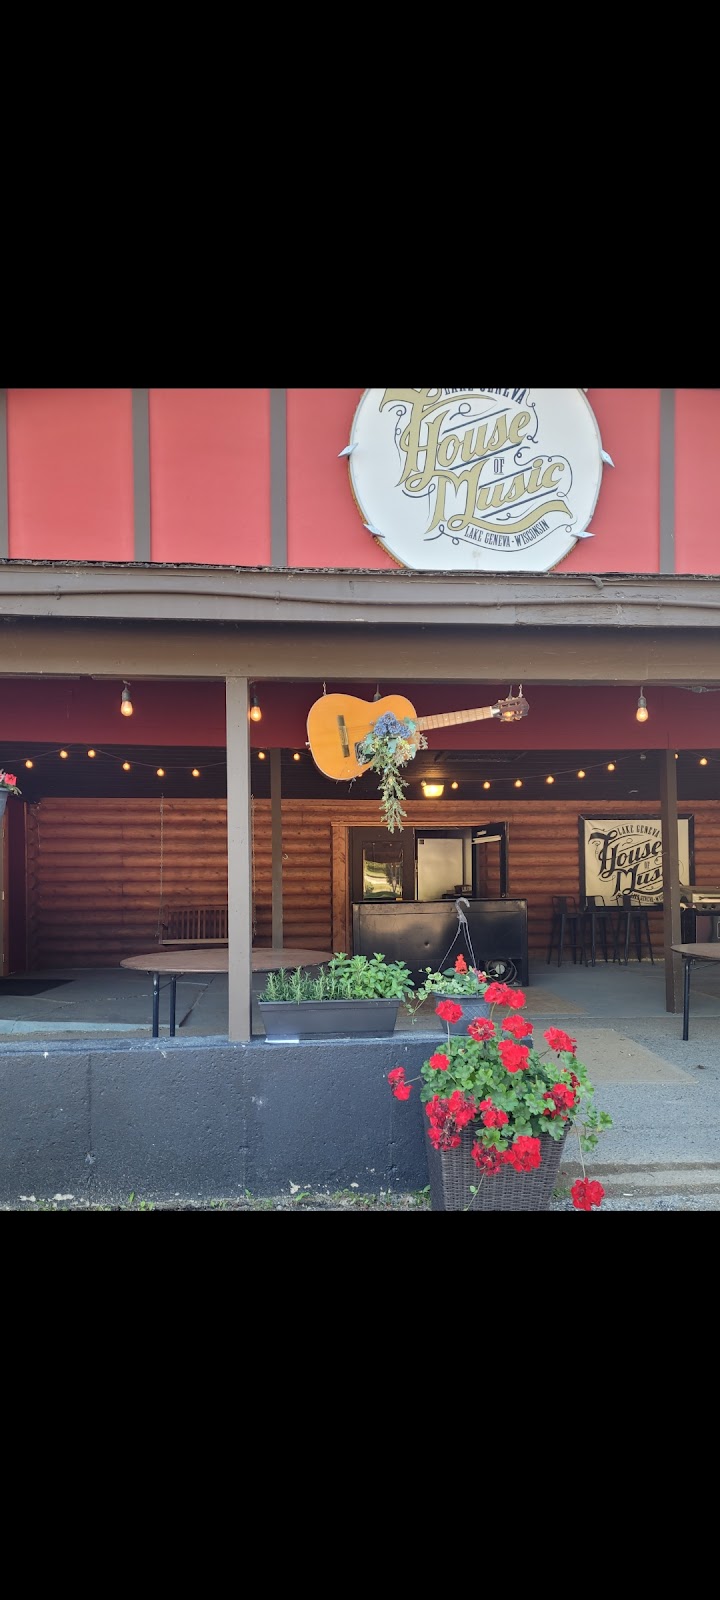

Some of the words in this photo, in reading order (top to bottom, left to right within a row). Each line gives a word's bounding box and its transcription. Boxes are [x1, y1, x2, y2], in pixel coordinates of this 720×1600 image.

[379, 388, 531, 488] House
[493, 457, 505, 474] OF
[424, 458, 565, 534] Music
[464, 525, 483, 542] LAKE
[484, 532, 511, 547] GENEVA
[514, 519, 550, 546] WISCONSIN
[617, 825, 634, 835] LAKE
[636, 825, 660, 838] GENEVA
[588, 832, 662, 878] House
[611, 863, 663, 897] Mus
